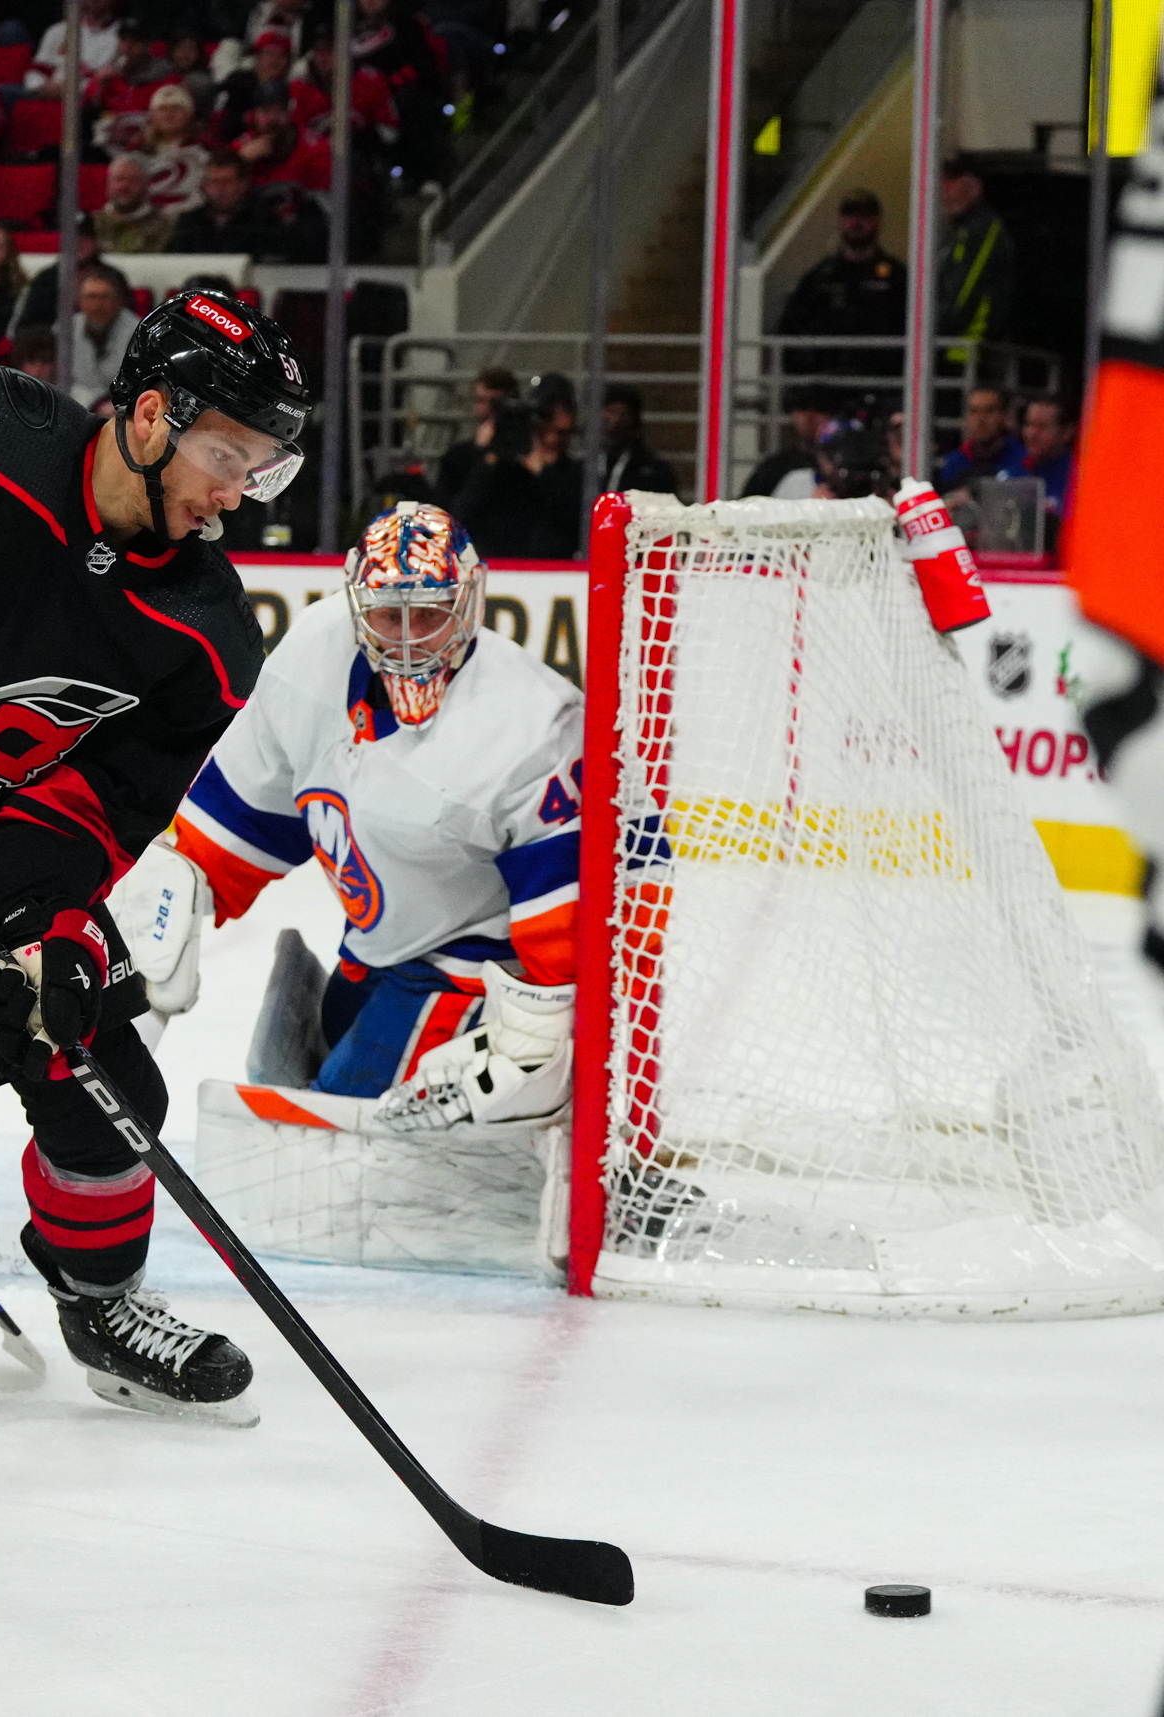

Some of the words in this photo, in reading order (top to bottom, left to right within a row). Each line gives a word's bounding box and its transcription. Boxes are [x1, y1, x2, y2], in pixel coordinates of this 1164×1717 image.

[190, 298, 243, 337] Lenovo
[278, 352, 303, 386] 58
[500, 983, 573, 1002] TRUE
